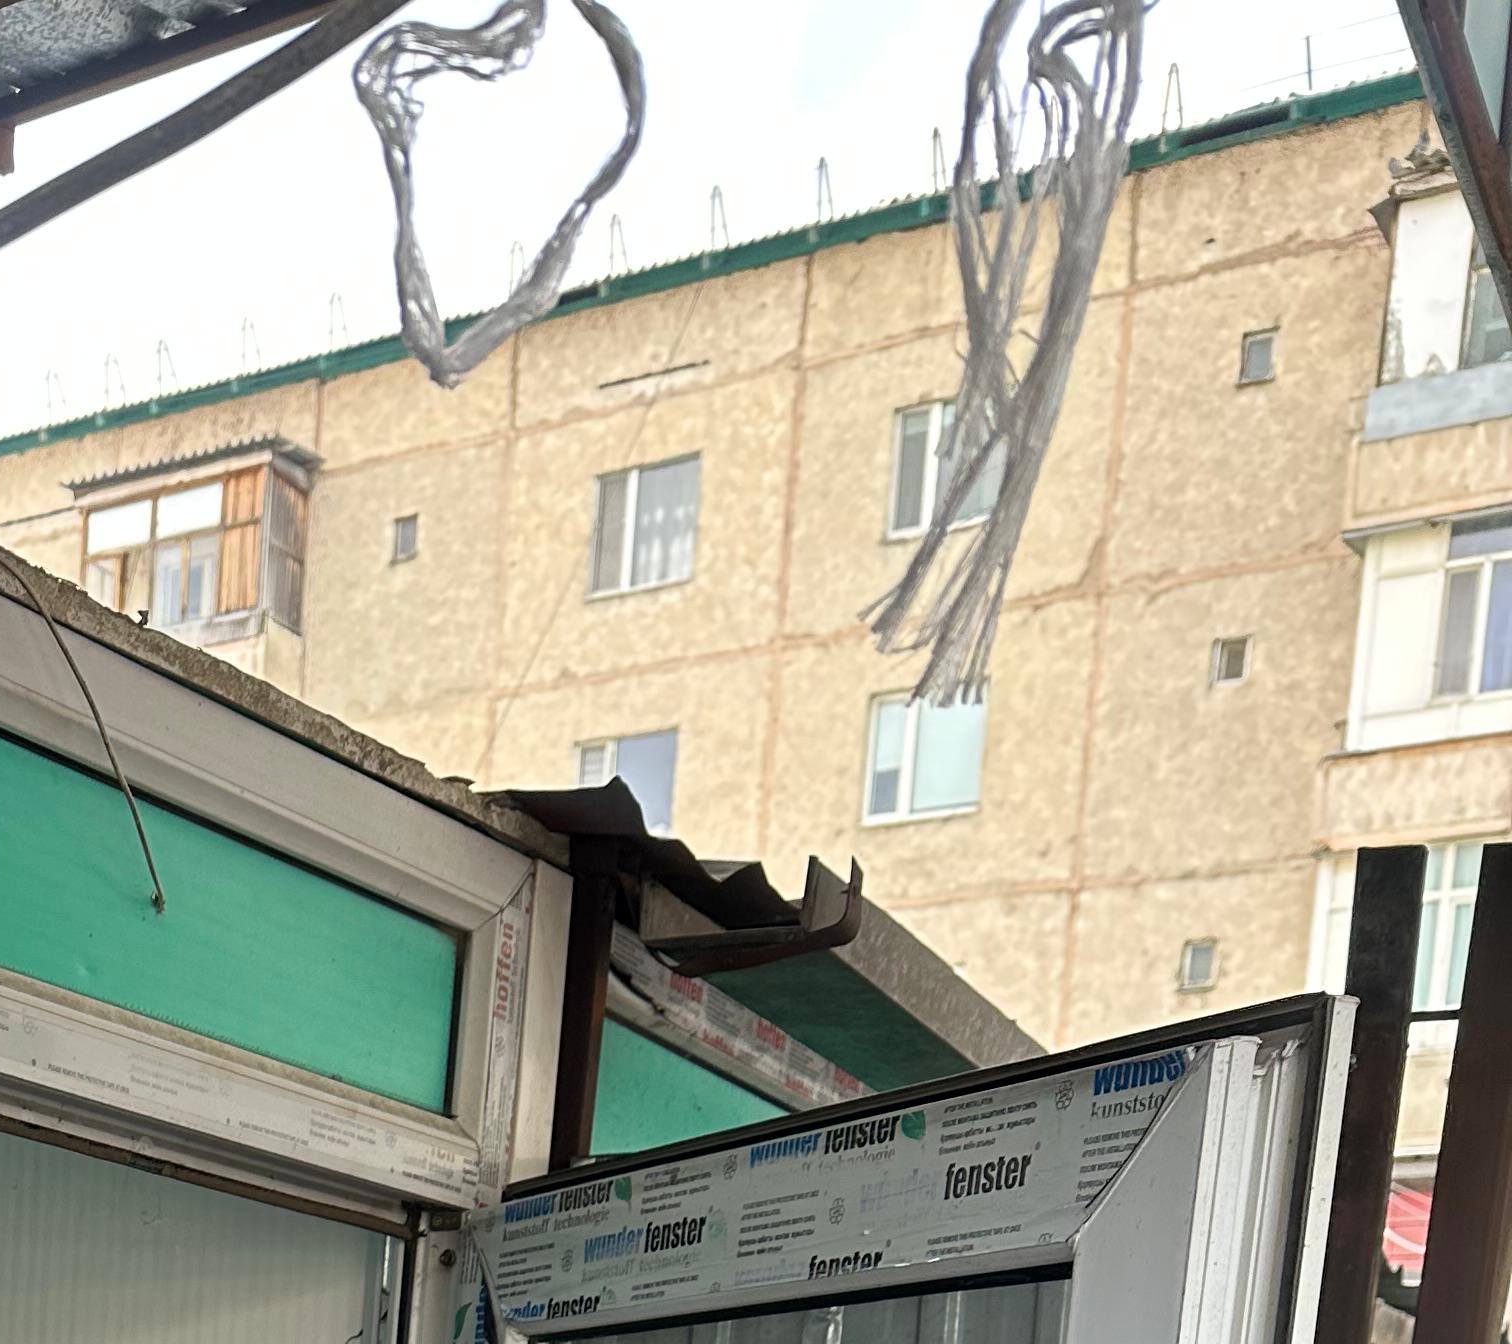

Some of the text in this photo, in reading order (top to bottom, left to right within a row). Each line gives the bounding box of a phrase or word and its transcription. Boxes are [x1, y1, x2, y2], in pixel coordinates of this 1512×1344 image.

[492, 922, 514, 1021] hoffen
[1090, 1093, 1167, 1120] kunststo
[943, 1153, 1033, 1200] fenster
[583, 1225, 645, 1264] wunder
[644, 1215, 707, 1253] fenster
